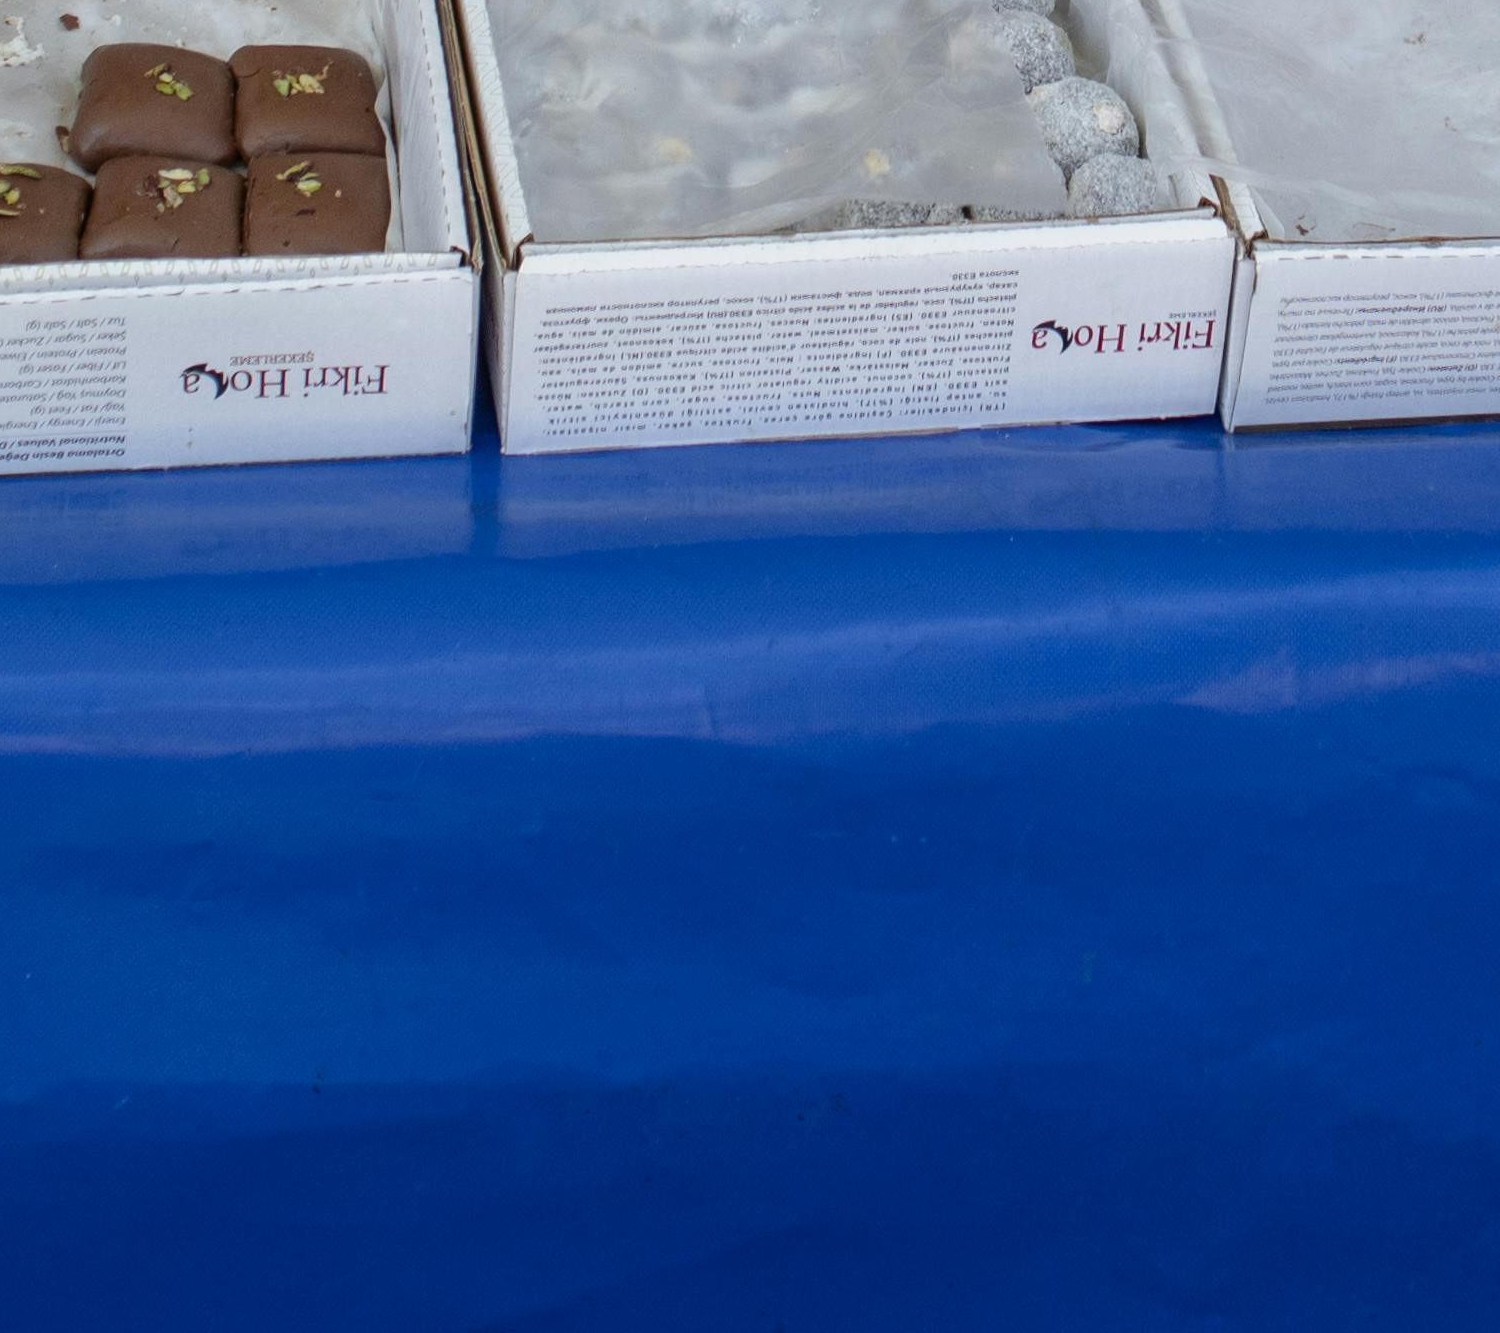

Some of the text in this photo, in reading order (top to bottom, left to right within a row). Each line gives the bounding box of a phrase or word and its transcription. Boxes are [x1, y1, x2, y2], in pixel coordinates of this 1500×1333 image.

[73, 317, 98, 328] Salt
[4, 336, 43, 347] Zucker
[1137, 319, 1217, 352] Fikri
[36, 348, 75, 360] Protein
[84, 345, 126, 357] Protein
[302, 365, 390, 399] Fikri
[17, 438, 56, 449] Values
[59, 434, 125, 446] Nutritional
[32, 450, 64, 460] Besin
